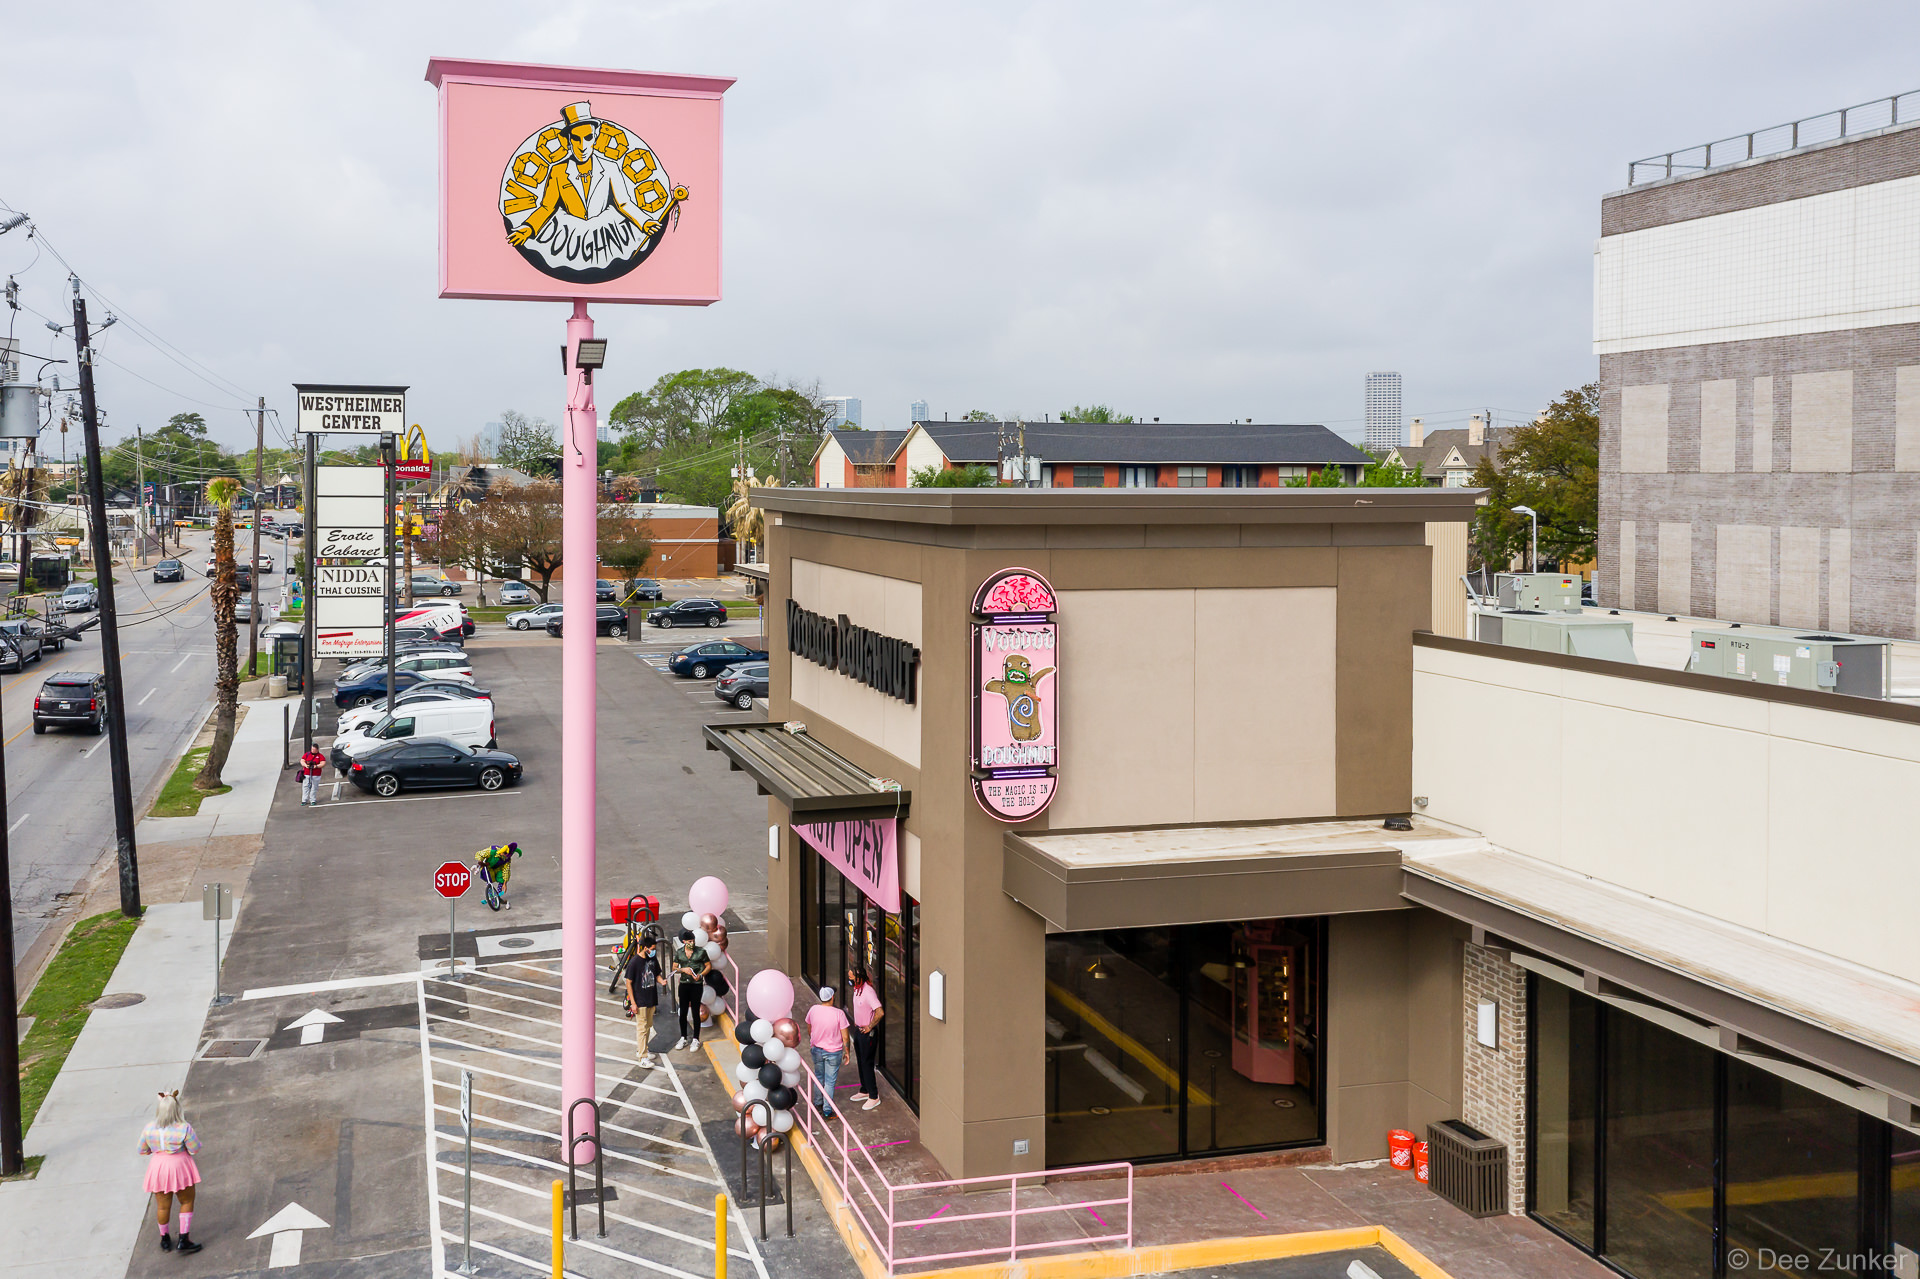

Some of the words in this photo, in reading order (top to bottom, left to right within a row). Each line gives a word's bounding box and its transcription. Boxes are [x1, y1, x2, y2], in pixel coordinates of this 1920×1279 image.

[536, 215, 637, 264] DOUGHNUT
[300, 396, 403, 412] WESTHEIMER
[322, 414, 381, 430] CENTER
[327, 529, 375, 542] Erotic
[320, 544, 381, 556] Cabaret
[321, 569, 380, 583] NIDDA
[344, 587, 382, 595] CUISINE
[786, 598, 838, 670] VOODOO
[838, 614, 921, 704] DOUGHNUT
[983, 744, 1057, 766] DOUGHNUT
[988, 786, 1002, 797] THE
[1005, 785, 1026, 796] MAGIC
[1029, 784, 1037, 795] IS
[1040, 784, 1048, 794] IN
[1002, 797, 1015, 807] THE
[1018, 796, 1036, 807] HOLE
[436, 872, 469, 888] STOP
